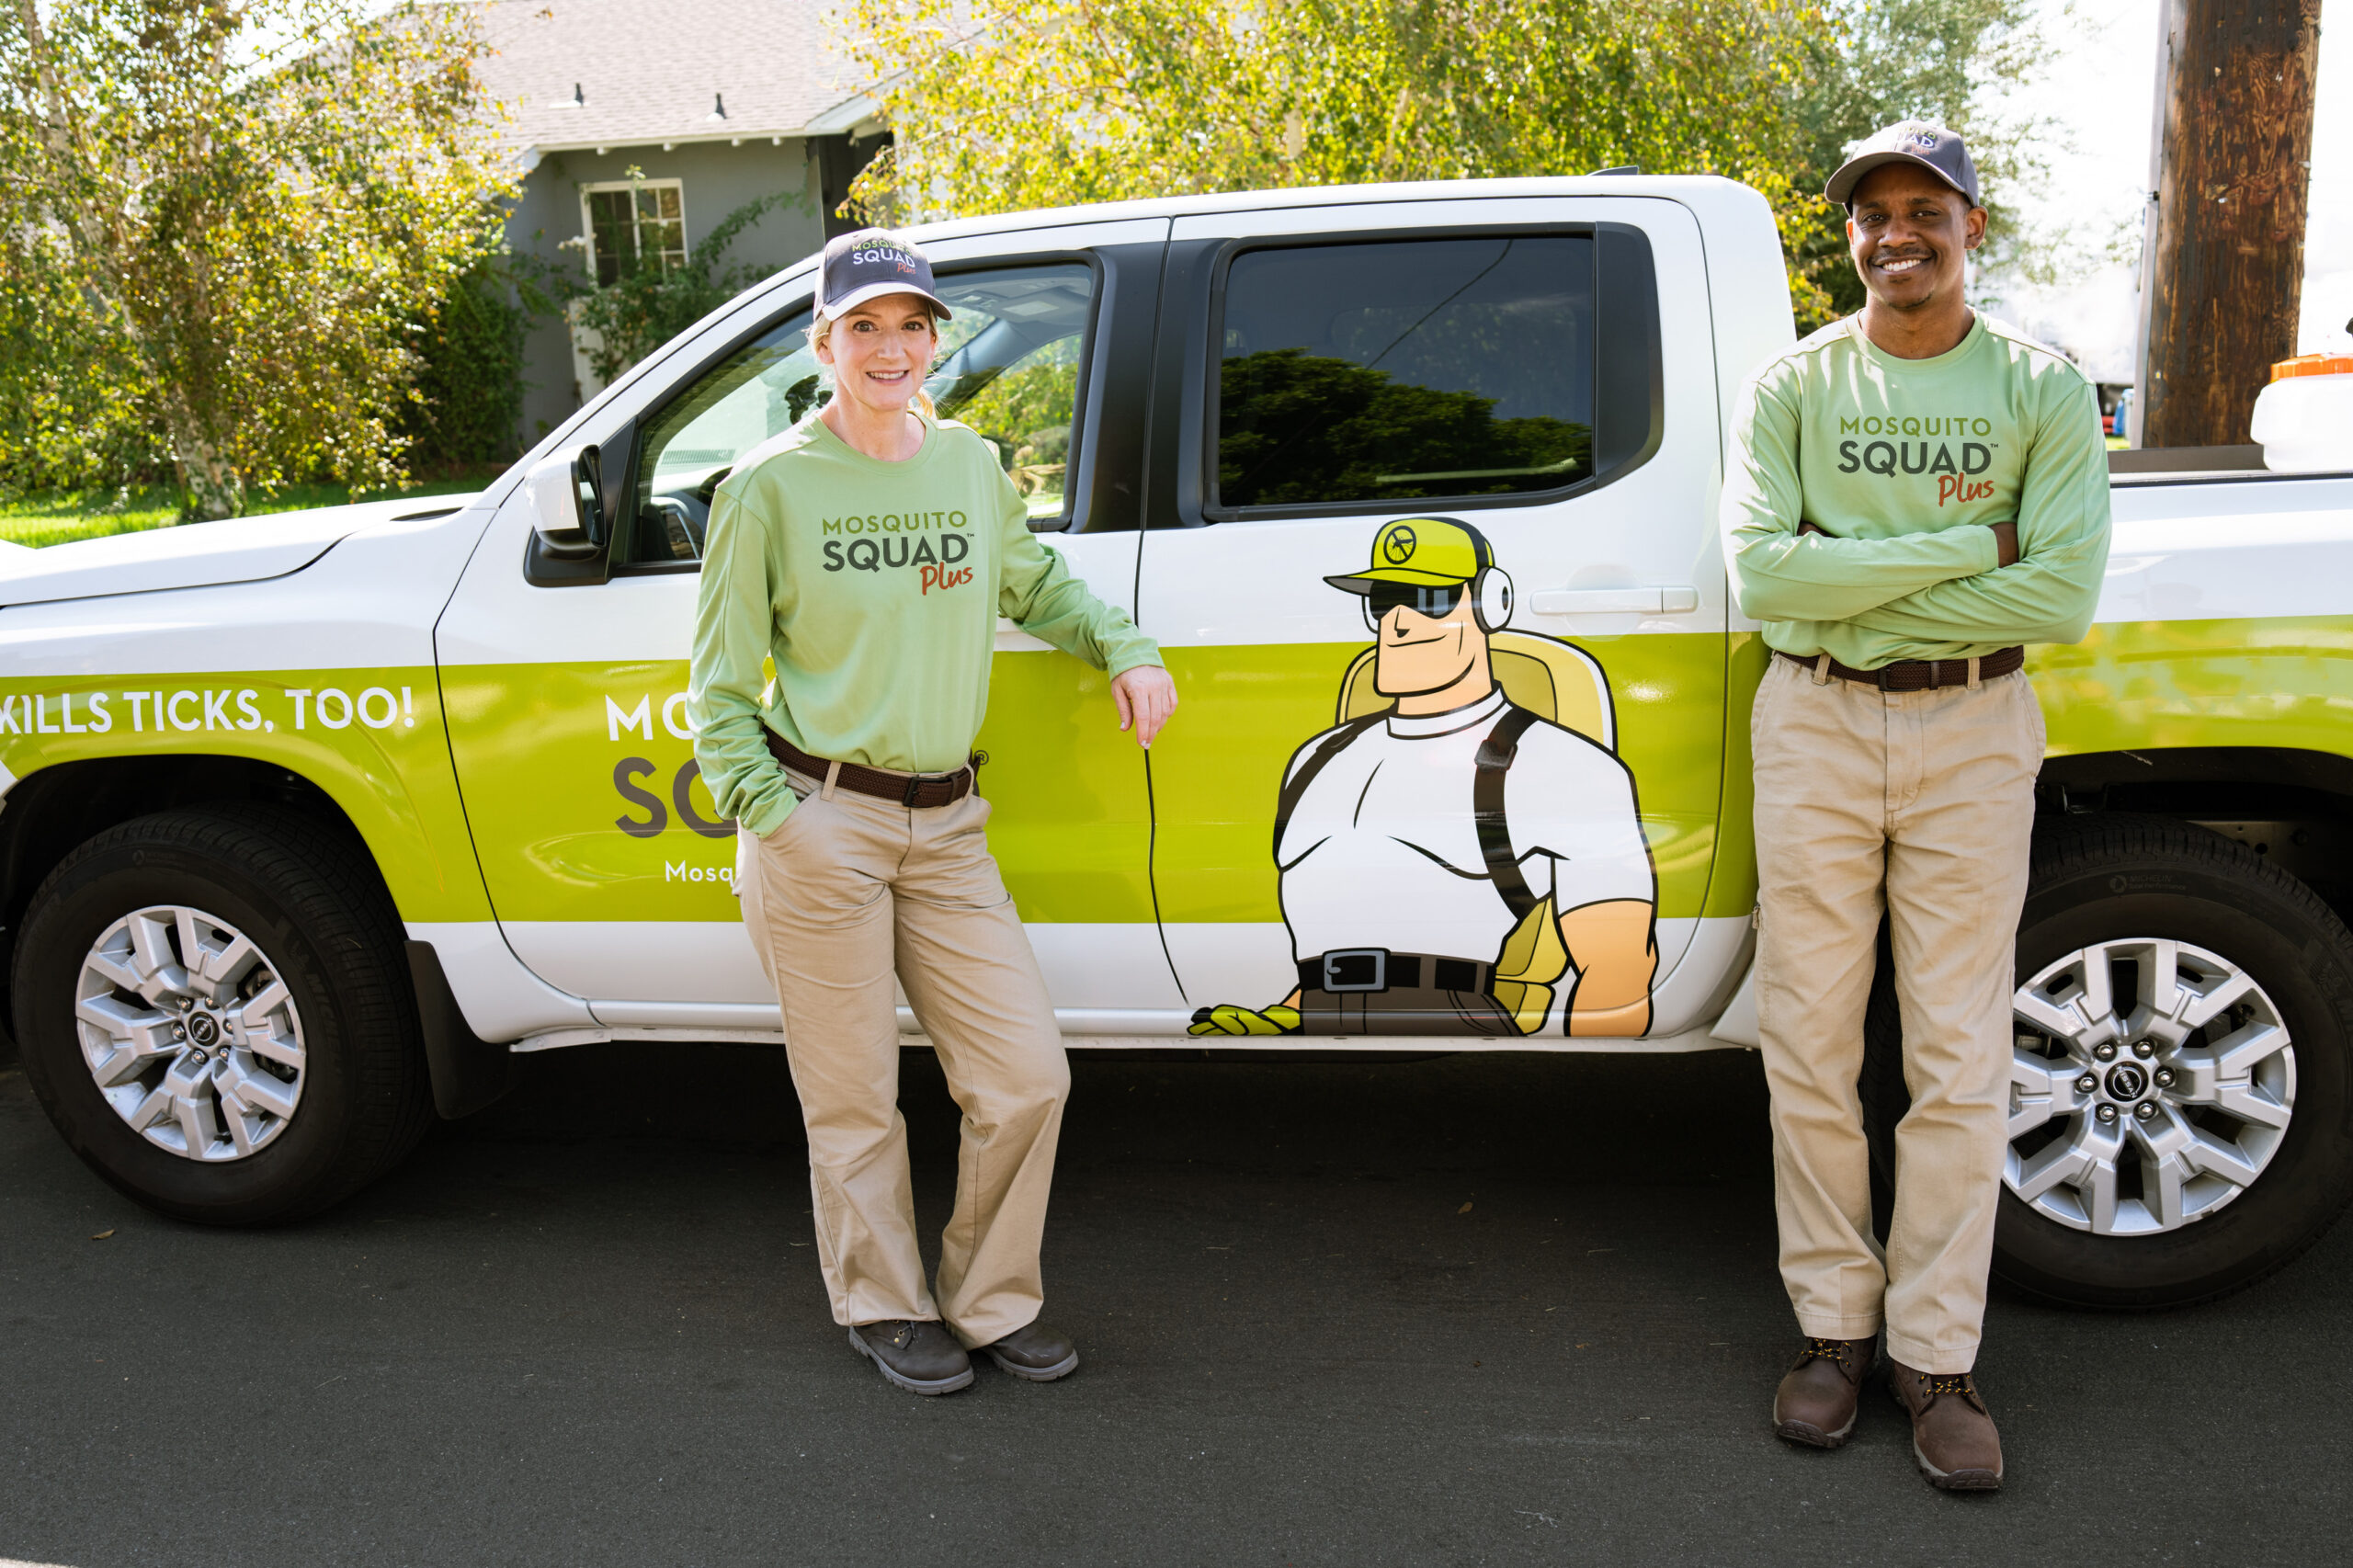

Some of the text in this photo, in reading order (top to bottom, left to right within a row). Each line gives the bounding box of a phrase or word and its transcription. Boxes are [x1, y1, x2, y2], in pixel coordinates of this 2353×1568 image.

[853, 248, 915, 268] SQUAD
[897, 262, 916, 275] Plus
[1840, 416, 1992, 437] MOSQUITO
[1837, 440, 1992, 478] SQUAD
[1938, 472, 1995, 507] Plus
[822, 510, 967, 536] MOSQUITO
[823, 533, 969, 573] SQUAD
[919, 562, 973, 596] Plus
[0, 687, 413, 734] KILLS TICKS, TOO!
[2116, 1064, 2138, 1098] NISSAN
